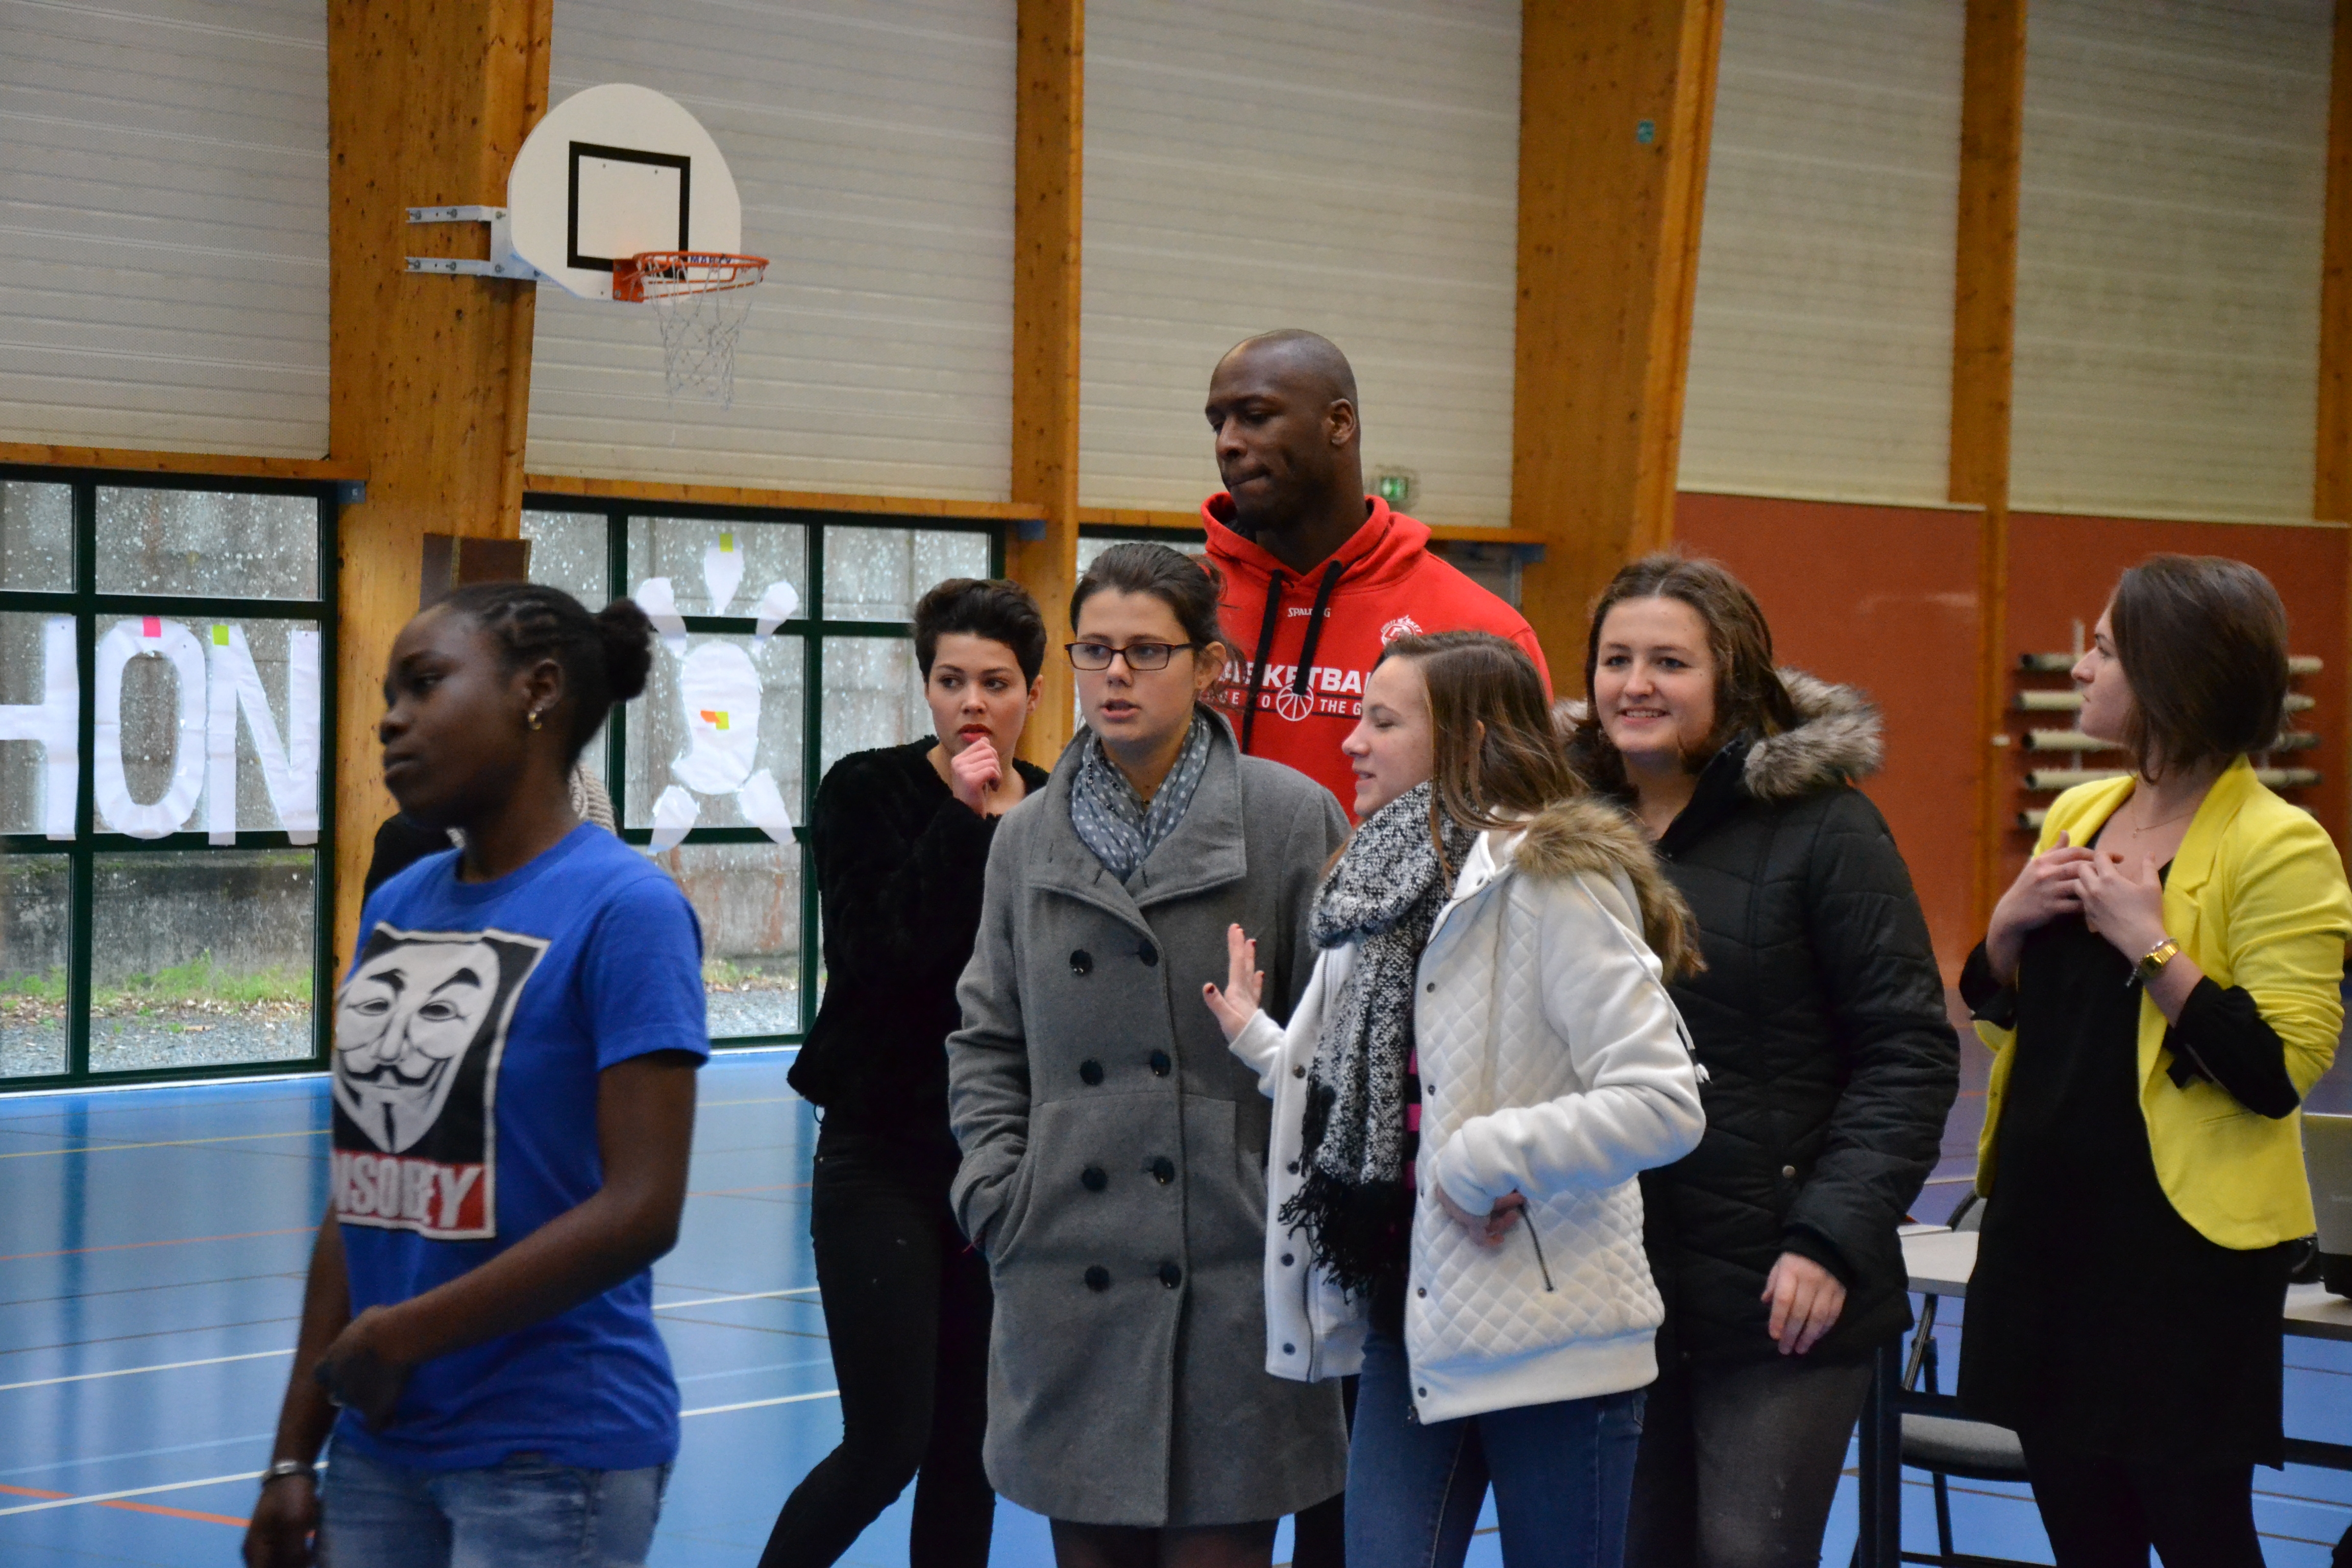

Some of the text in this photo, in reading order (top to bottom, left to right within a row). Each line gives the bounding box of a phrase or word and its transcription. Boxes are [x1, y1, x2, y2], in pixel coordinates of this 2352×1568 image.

[1288, 607, 1331, 618] SPALG
[1320, 699, 1346, 714] THE
[0, 616, 319, 845] HON
